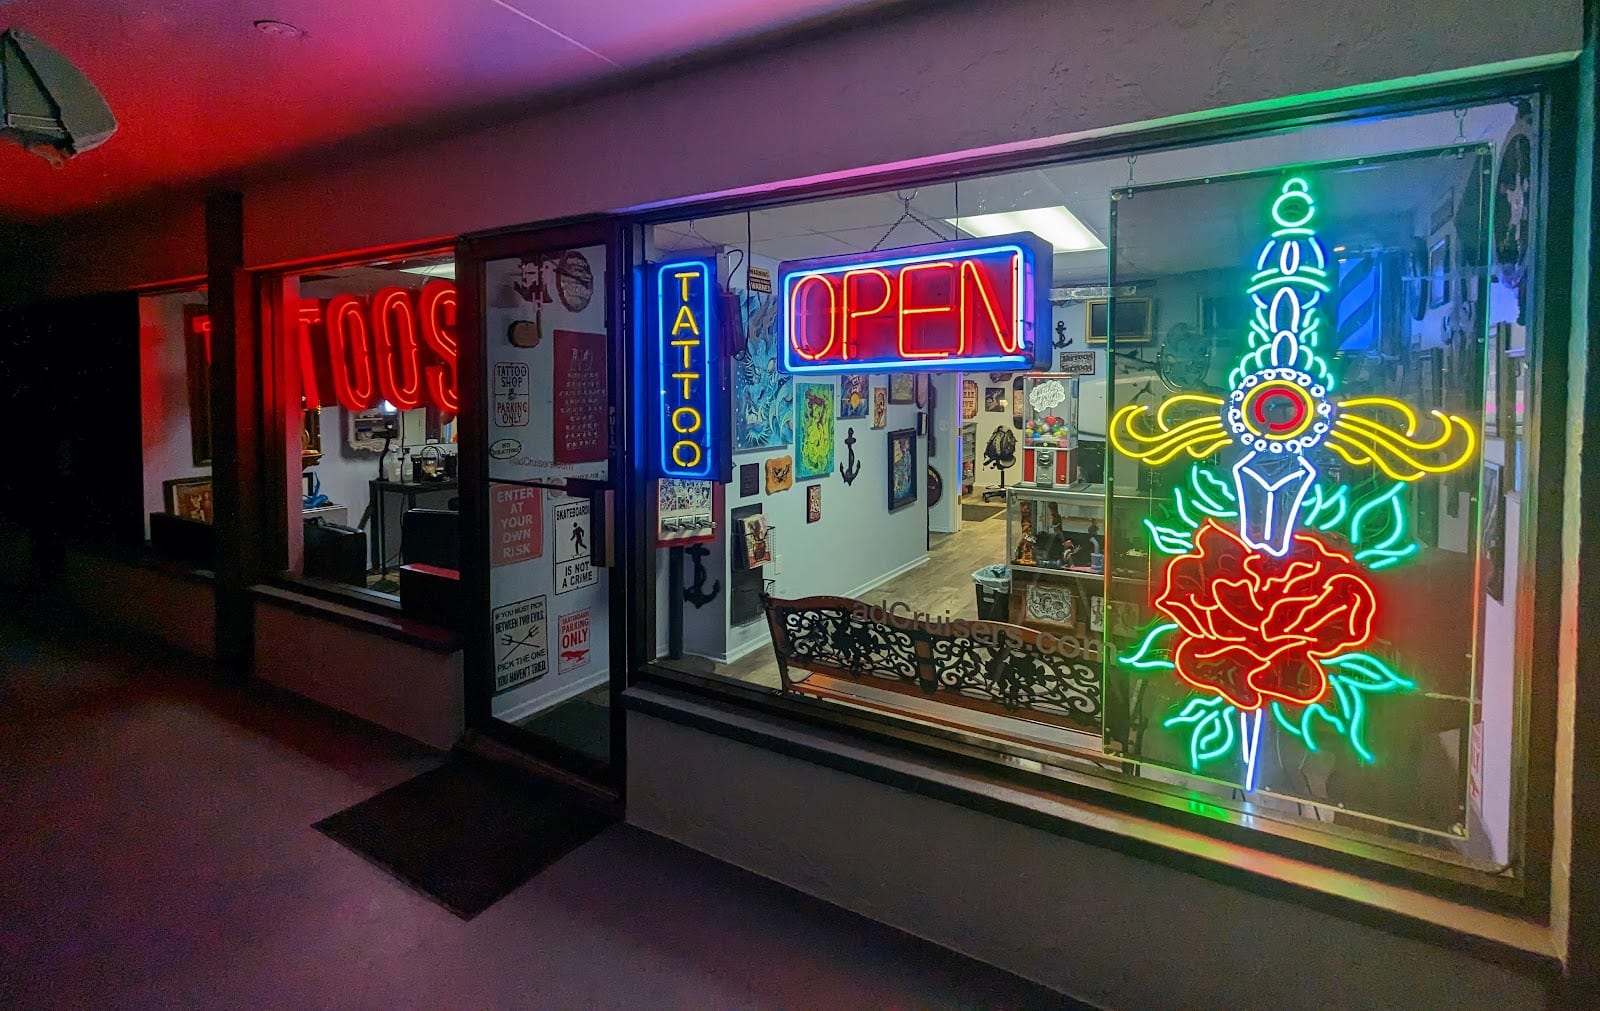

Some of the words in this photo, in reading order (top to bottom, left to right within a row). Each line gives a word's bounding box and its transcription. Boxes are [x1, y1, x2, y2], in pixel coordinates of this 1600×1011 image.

[791, 254, 1019, 360] OPEN
[497, 365, 527, 377] TATTOO
[671, 272, 701, 468] TATTOO
[501, 376, 523, 388] SHOP
[497, 401, 528, 414] PARKING
[502, 412, 522, 424] ONLY
[497, 487, 534, 502] ENTER
[510, 501, 524, 514] AT
[500, 514, 533, 529] YOUR
[502, 528, 531, 544] OWN
[503, 543, 530, 559] RISK
[565, 565, 572, 576] IS
[575, 561, 590, 574] NOT
[562, 578, 567, 588] A
[570, 571, 592, 586] CRIME
[501, 609, 514, 618] YOU
[514, 604, 529, 614] MUST
[531, 601, 544, 610] PICK
[496, 618, 518, 633] BETWEEN
[520, 614, 530, 626] TWO
[561, 617, 589, 634] PARKING
[562, 627, 588, 649] ONLY
[497, 660, 514, 672] PICK
[516, 654, 530, 665] THE
[531, 648, 546, 660] ONE
[498, 673, 509, 687] YOU
